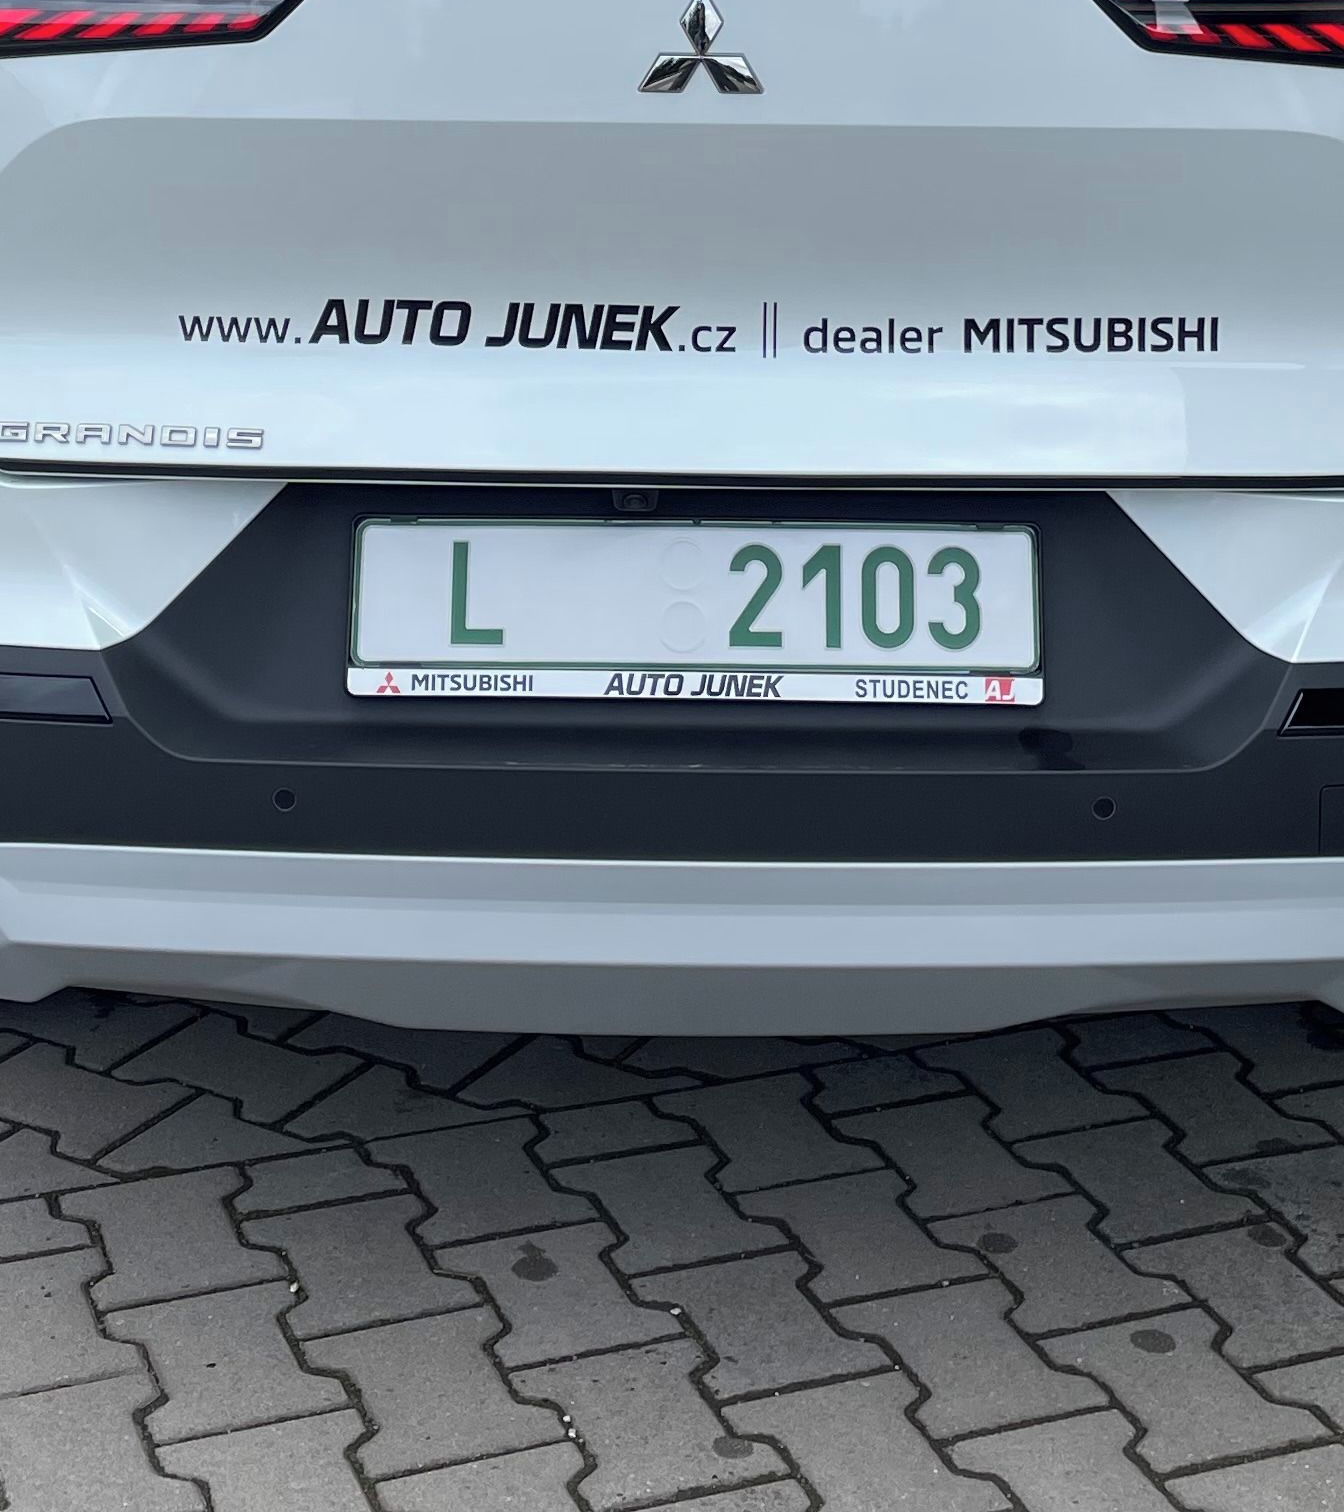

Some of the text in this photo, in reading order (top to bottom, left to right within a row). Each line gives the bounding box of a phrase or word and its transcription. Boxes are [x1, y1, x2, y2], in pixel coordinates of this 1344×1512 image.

[802, 317, 944, 355] dealer
[962, 316, 1220, 354] MITSUBISHI
[450, 539, 982, 651] L 2103
[410, 673, 534, 692] MITSUBISHI
[604, 672, 685, 696] AUTO
[691, 673, 786, 698] JUNEK
[855, 678, 969, 700] STUDENEC
